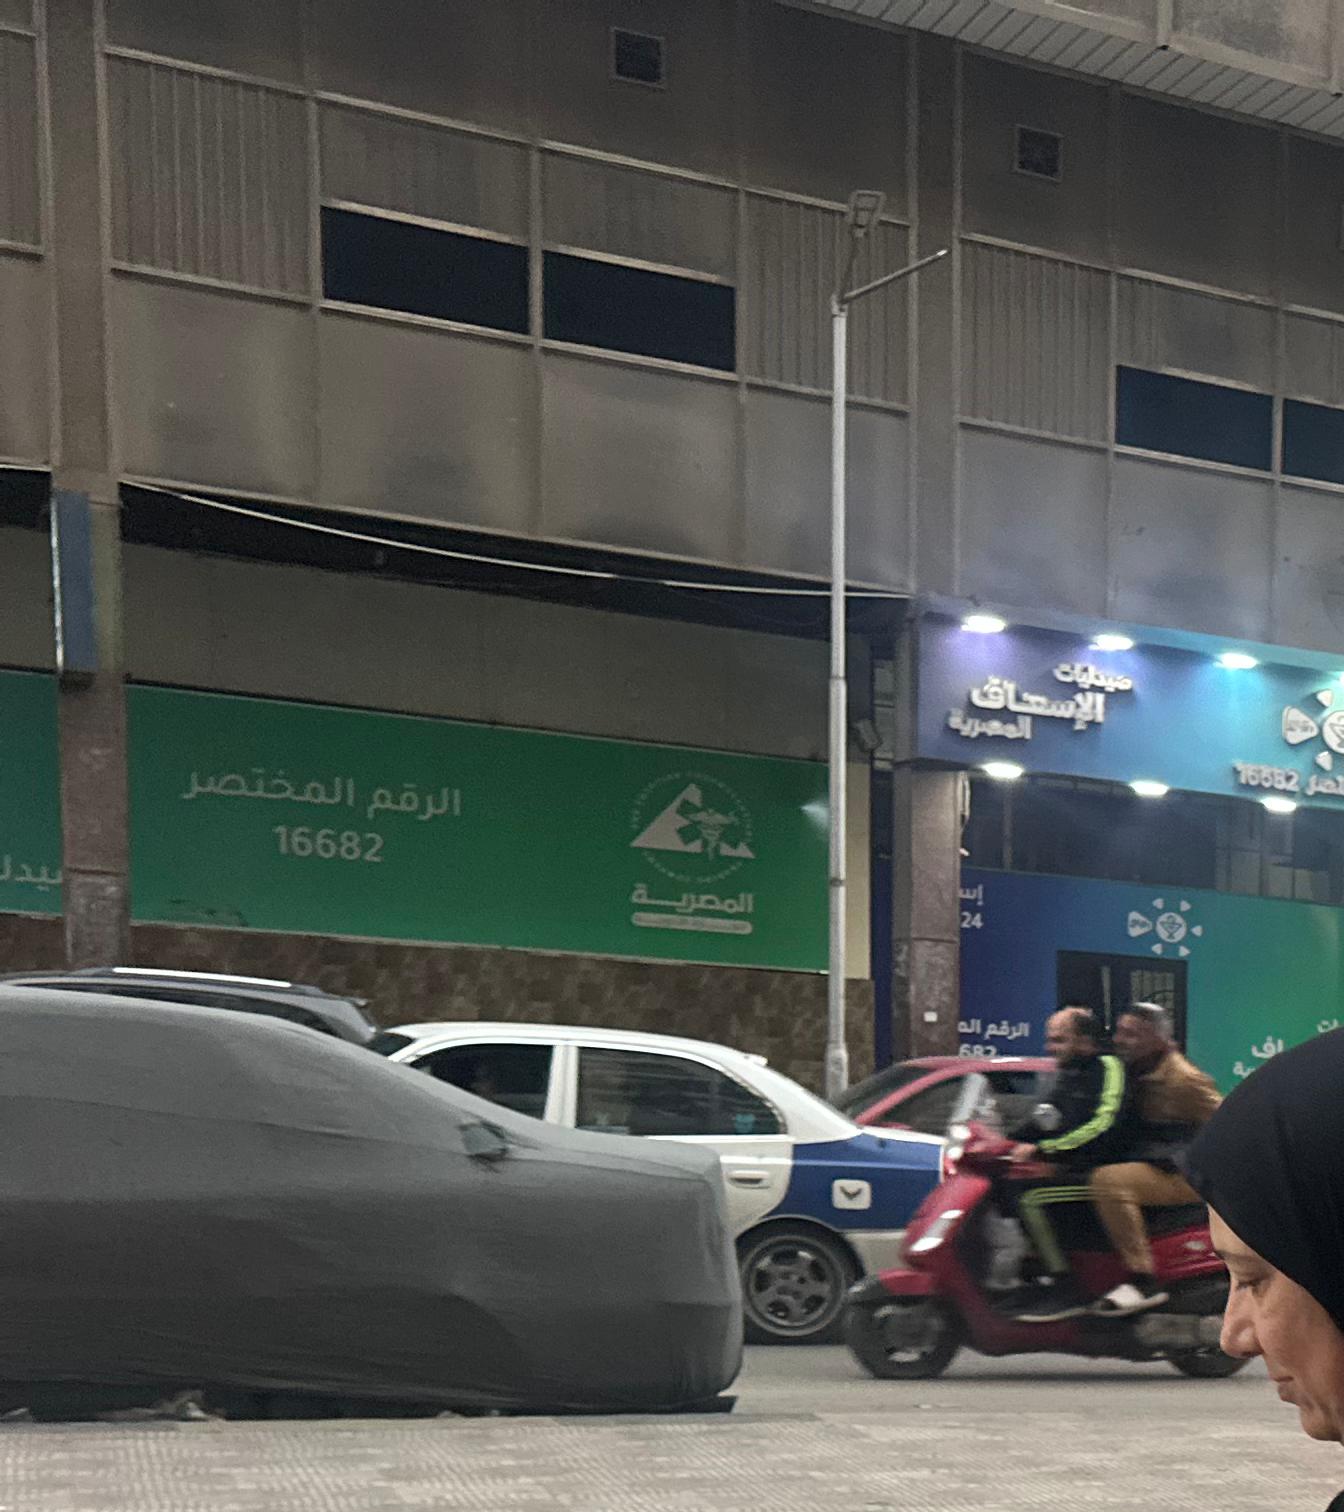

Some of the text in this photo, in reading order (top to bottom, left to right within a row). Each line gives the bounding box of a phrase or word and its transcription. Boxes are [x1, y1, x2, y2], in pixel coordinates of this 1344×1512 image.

[949, 707, 1032, 739] المصرية
[181, 767, 461, 821] الرقم المختصر
[272, 824, 384, 862] 16682
[631, 883, 753, 913] المصرية
[961, 911, 983, 928] 24
[985, 1020, 1030, 1040] الرقم
[959, 1043, 998, 1058] 682
